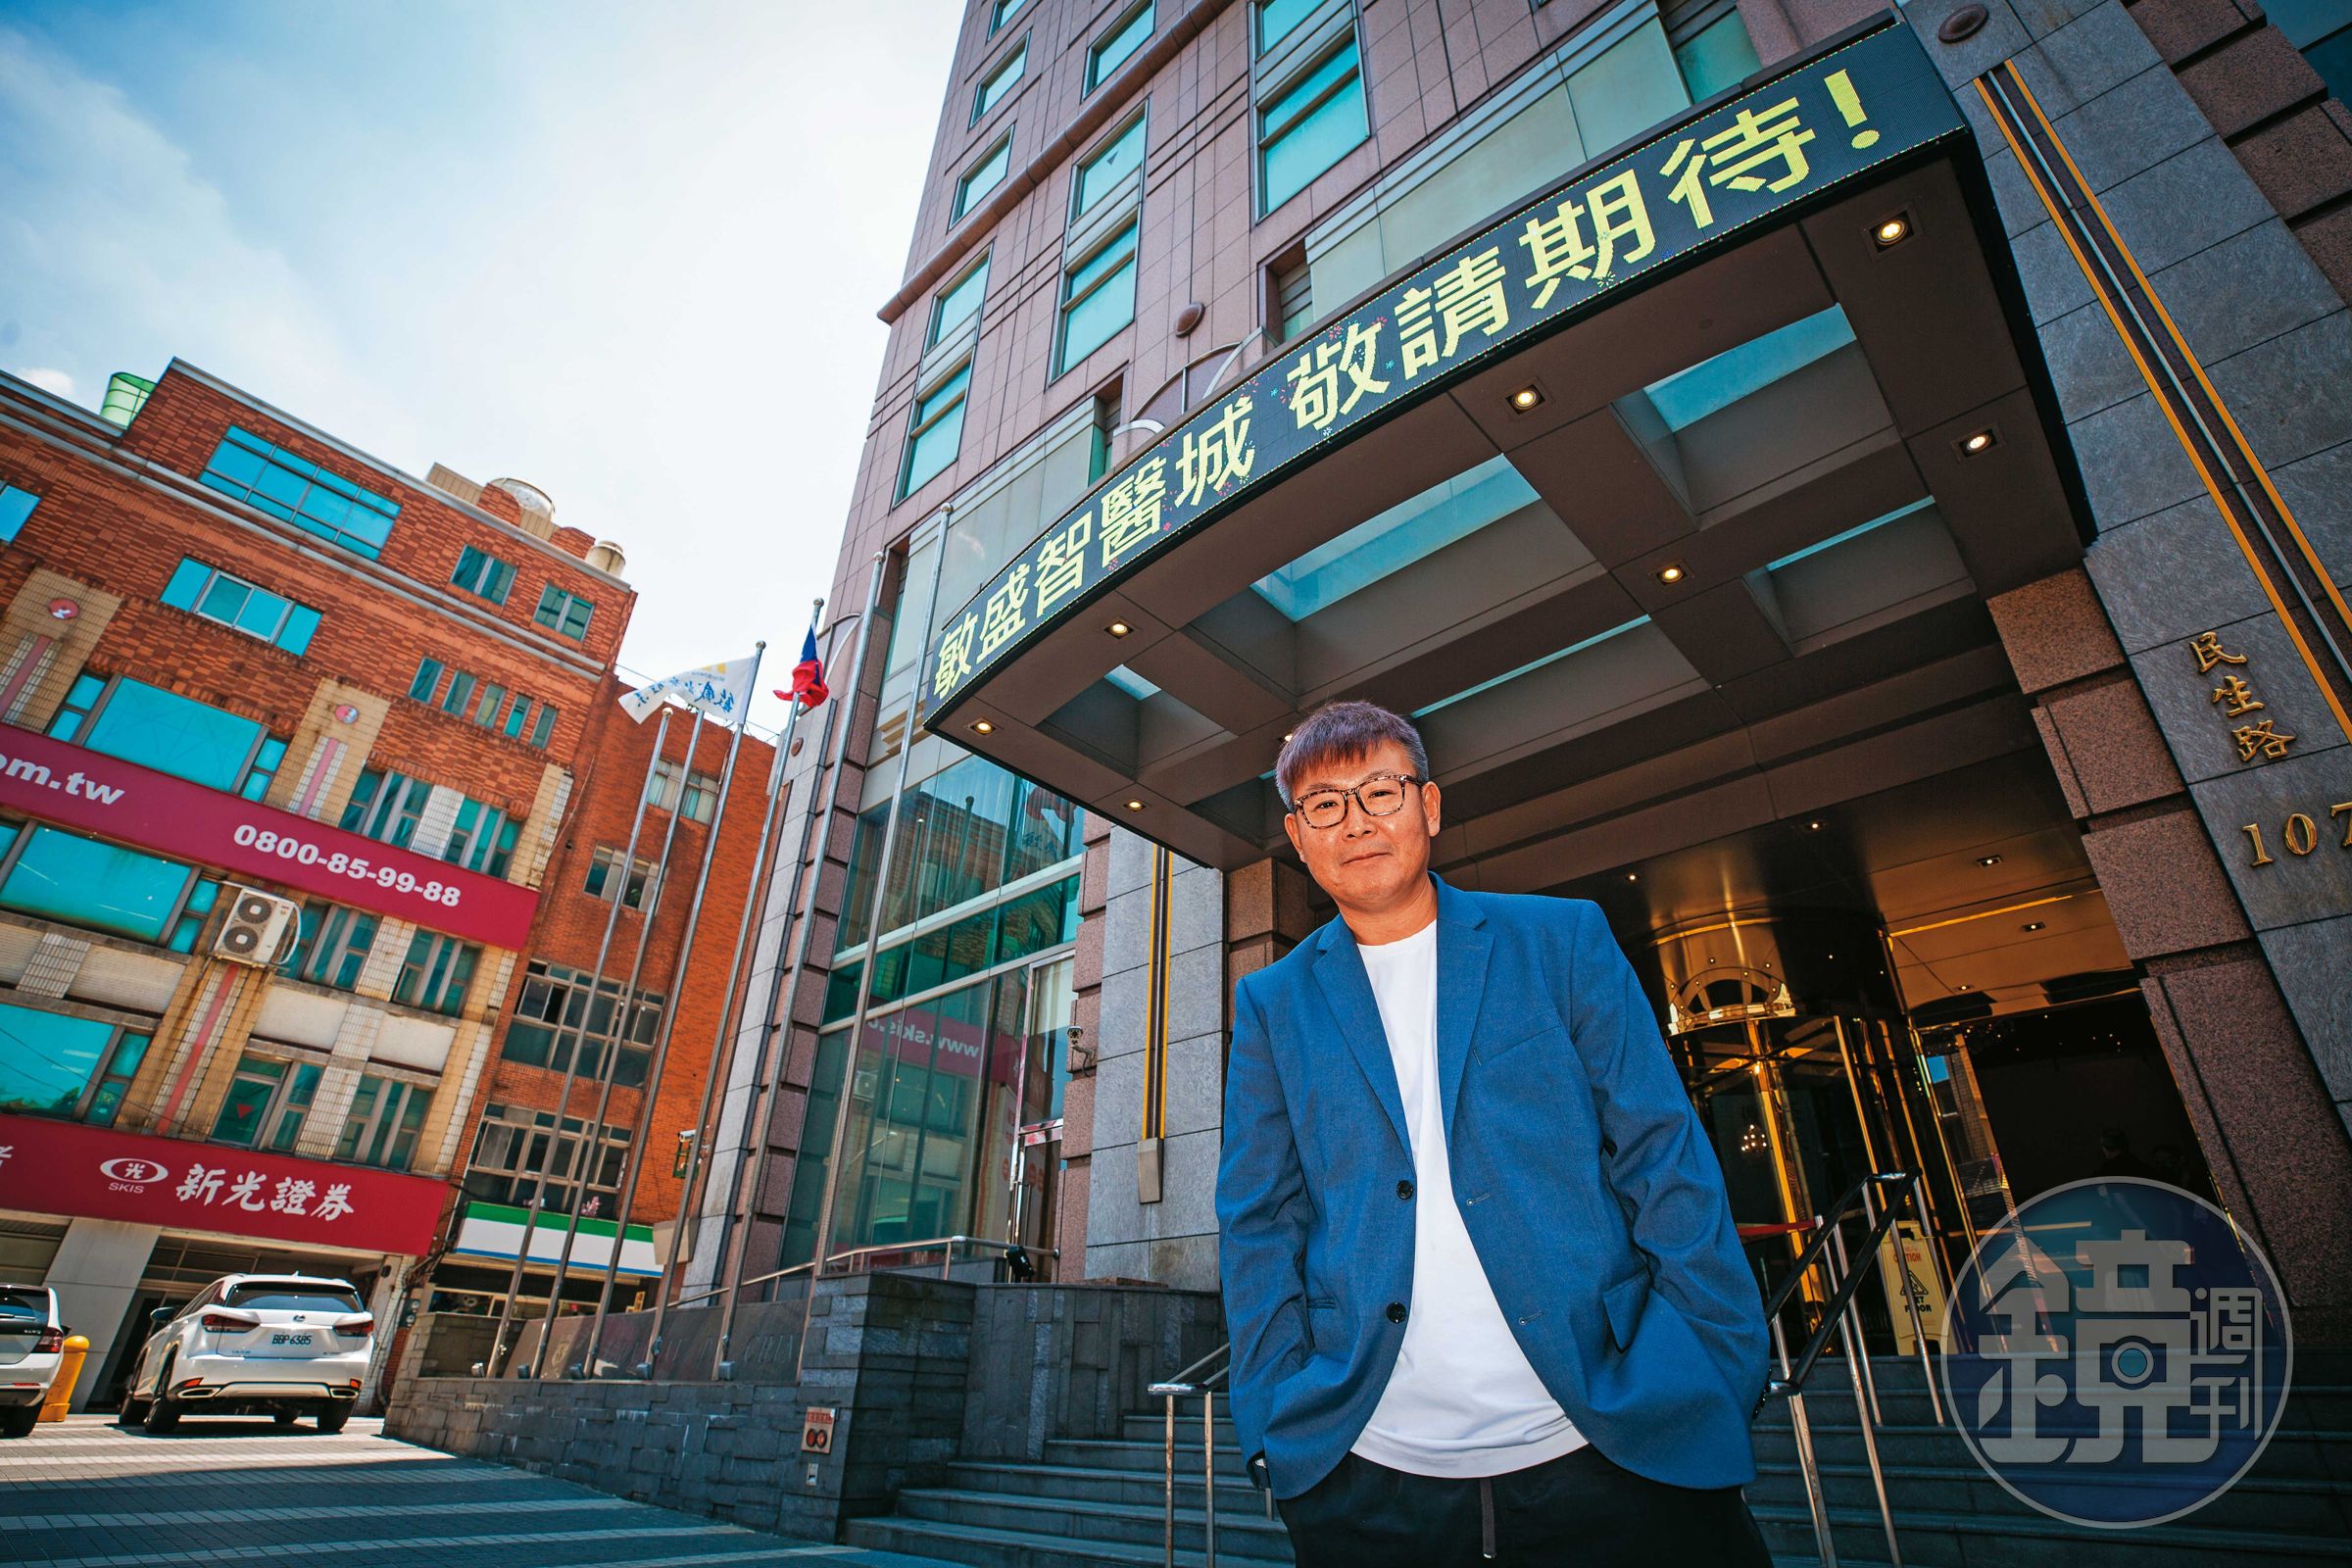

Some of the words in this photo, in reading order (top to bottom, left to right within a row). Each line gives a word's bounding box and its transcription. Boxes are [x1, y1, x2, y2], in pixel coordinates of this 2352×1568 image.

[933, 396, 1255, 700] 敏盛智醫城
[2189, 631, 2297, 762] 民生路
[233, 823, 461, 908] 0800-85-99-88
[2242, 802, 2352, 867] 107
[108, 1182, 145, 1194] SKIS
[176, 1163, 354, 1221] 新光證券
[1893, 1252, 1922, 1263] CTION
